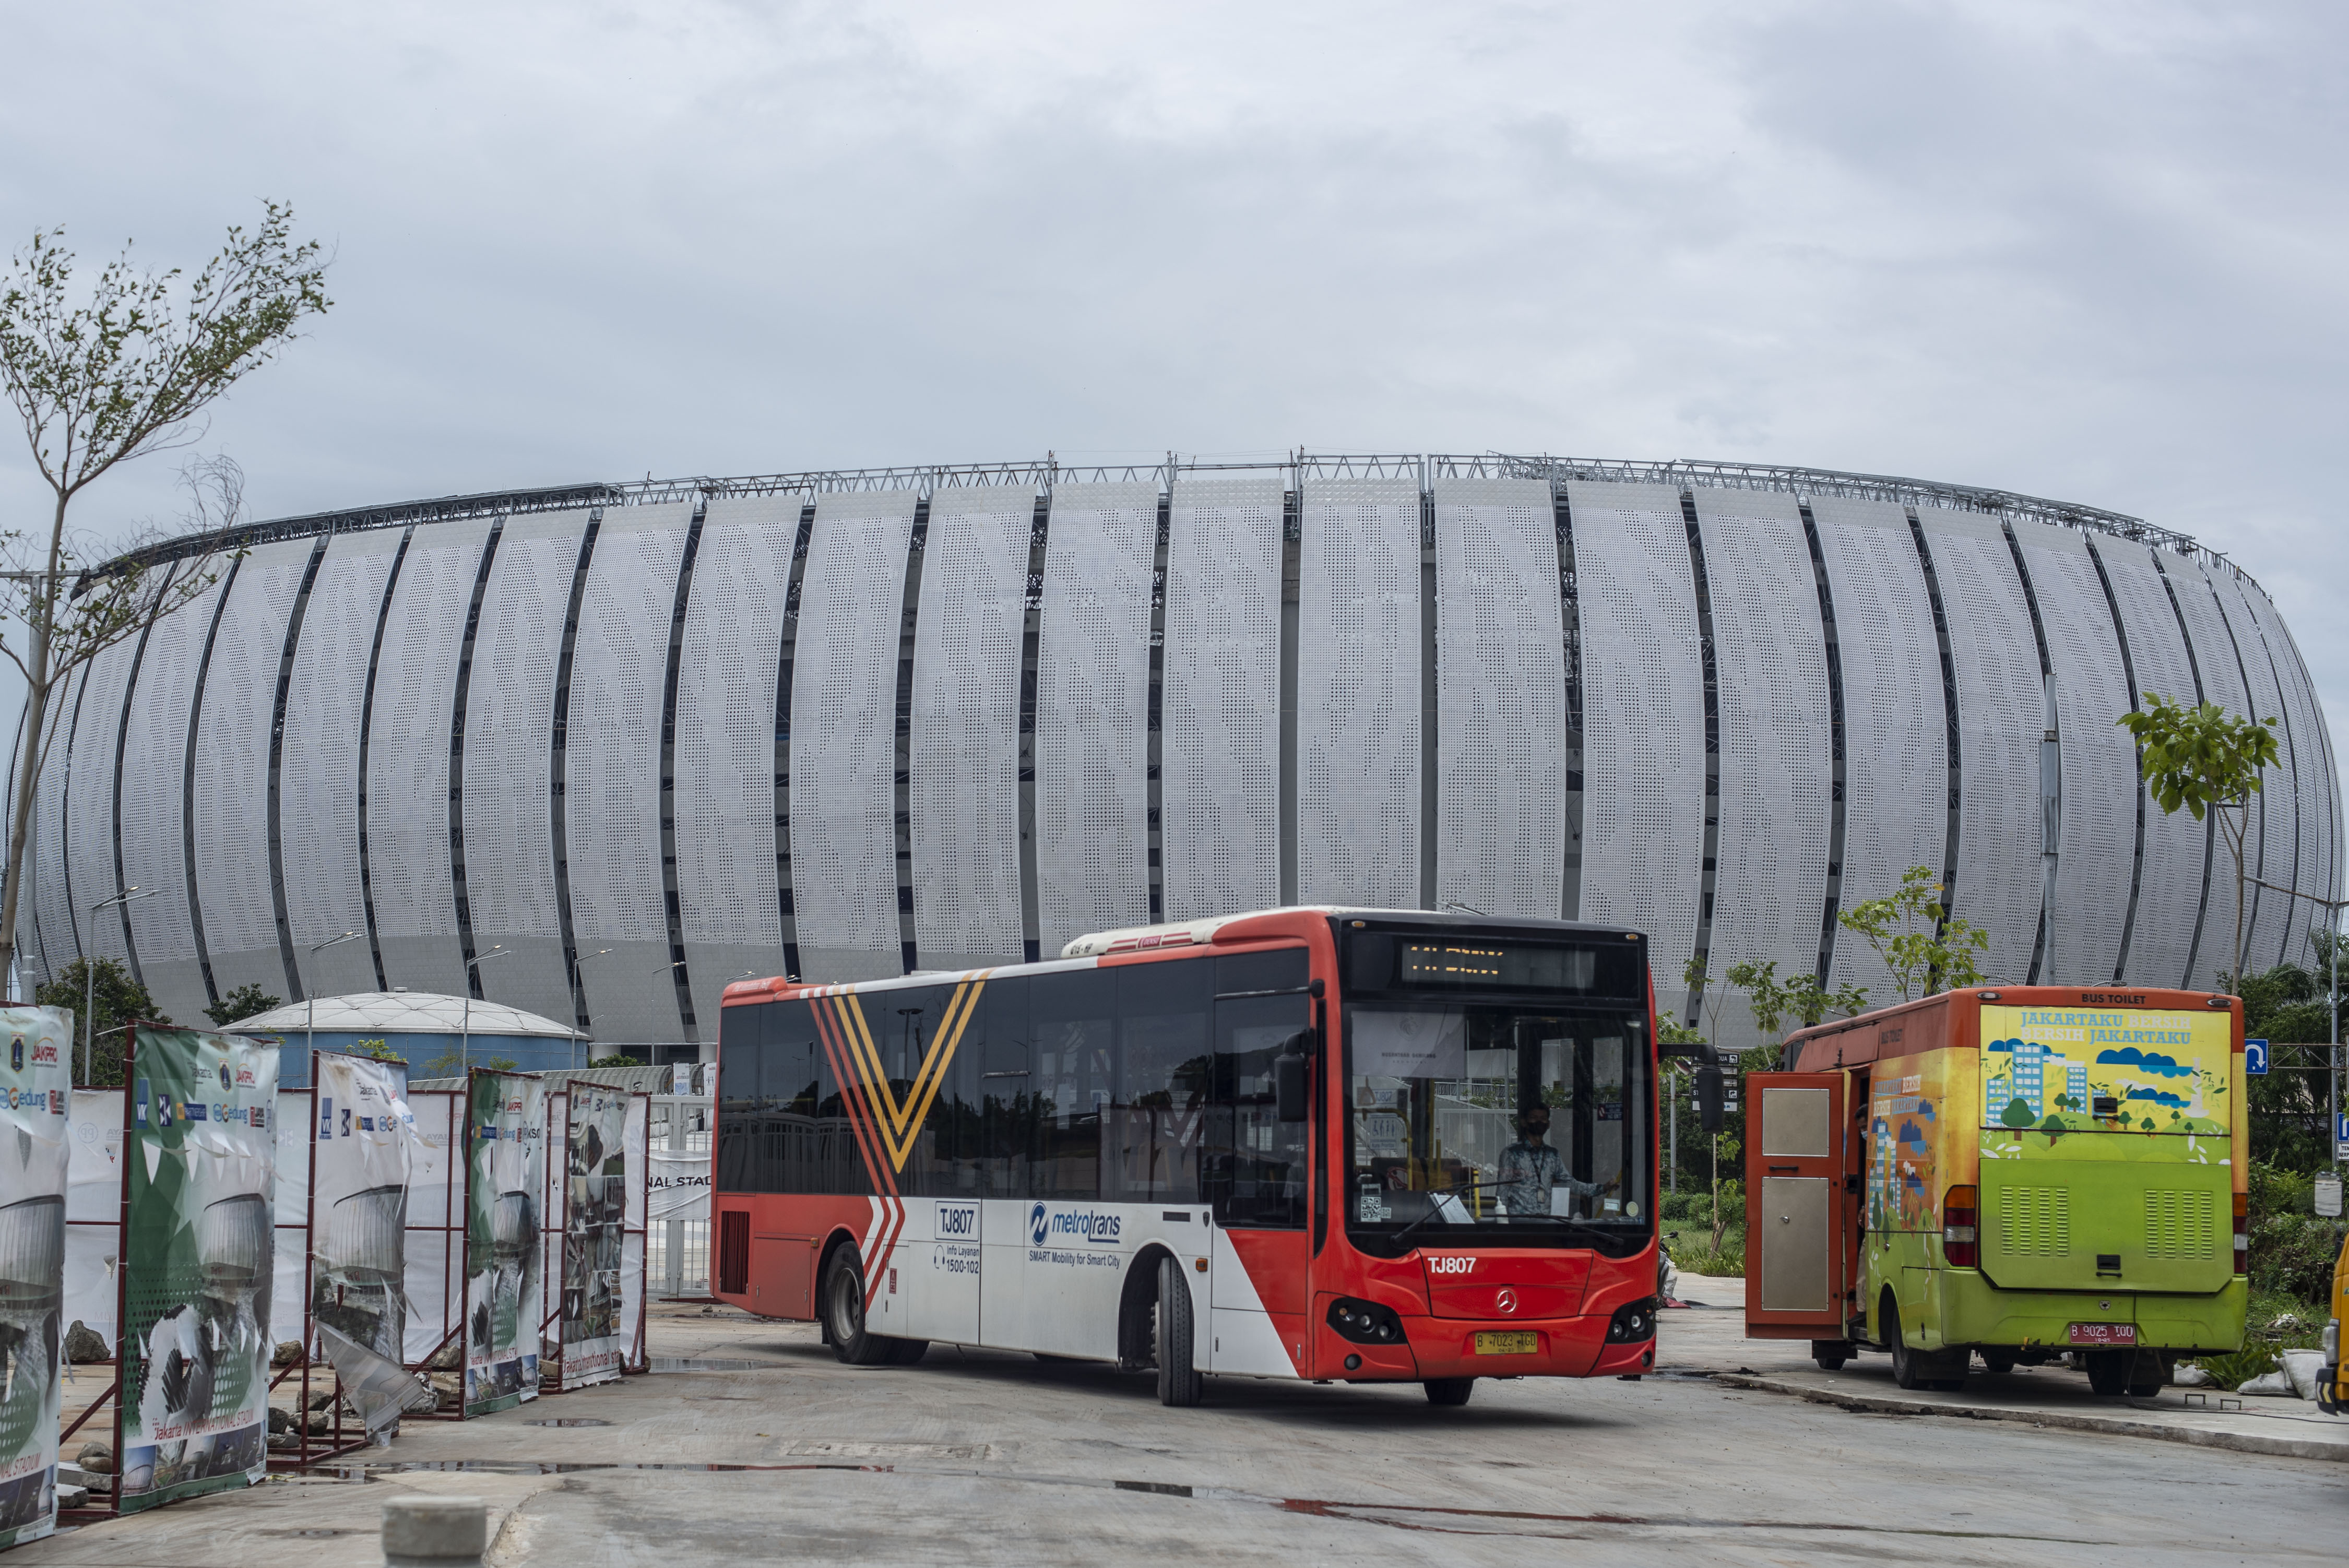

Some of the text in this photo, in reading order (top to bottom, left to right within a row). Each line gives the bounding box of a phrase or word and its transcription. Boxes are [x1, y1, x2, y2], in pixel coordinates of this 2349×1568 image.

[2082, 994, 2146, 1004] BUS TOILET
[2020, 1012, 2191, 1029] JAKARTAKU BERSIH
[2020, 1027, 2191, 1044] BERSIH JAKARTAKU
[1902, 1074, 1921, 1093] BERSIH
[940, 1208, 974, 1234] TJ807
[1052, 1209, 1121, 1243] metrotrans
[947, 1245, 979, 1258] Info Layanan
[1029, 1250, 1120, 1269] SMART Mobility for Smart City
[1427, 1257, 1477, 1274] TJ807
[2071, 1325, 2078, 1336] B
[2083, 1325, 2107, 1336] 9025
[1477, 1335, 1482, 1347] B
[1491, 1334, 1513, 1347] 7023
[154, 1423, 182, 1440] Jakarta
